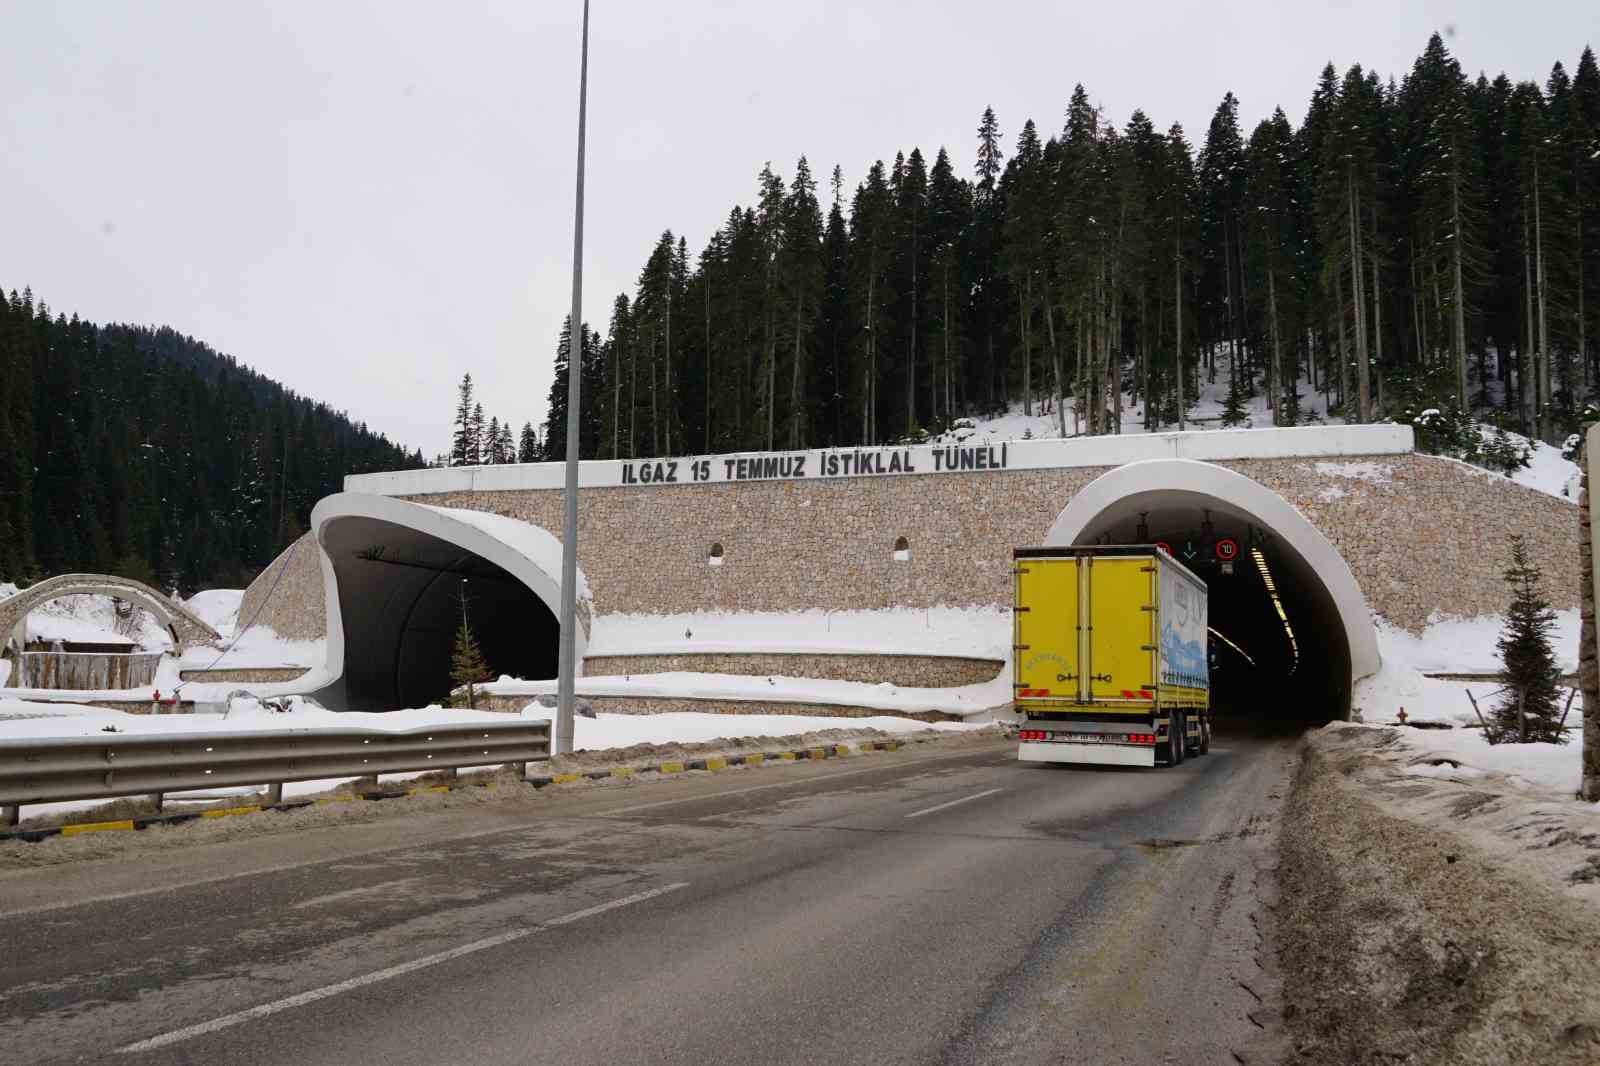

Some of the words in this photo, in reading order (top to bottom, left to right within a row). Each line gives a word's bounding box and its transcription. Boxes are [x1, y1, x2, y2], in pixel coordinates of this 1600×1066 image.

[621, 460, 677, 484] ILGAZ
[690, 459, 710, 481] 15
[724, 455, 806, 480] TEMMUZ
[820, 448, 914, 475] İSTİKLAL
[931, 442, 1007, 470] TÜNELİ
